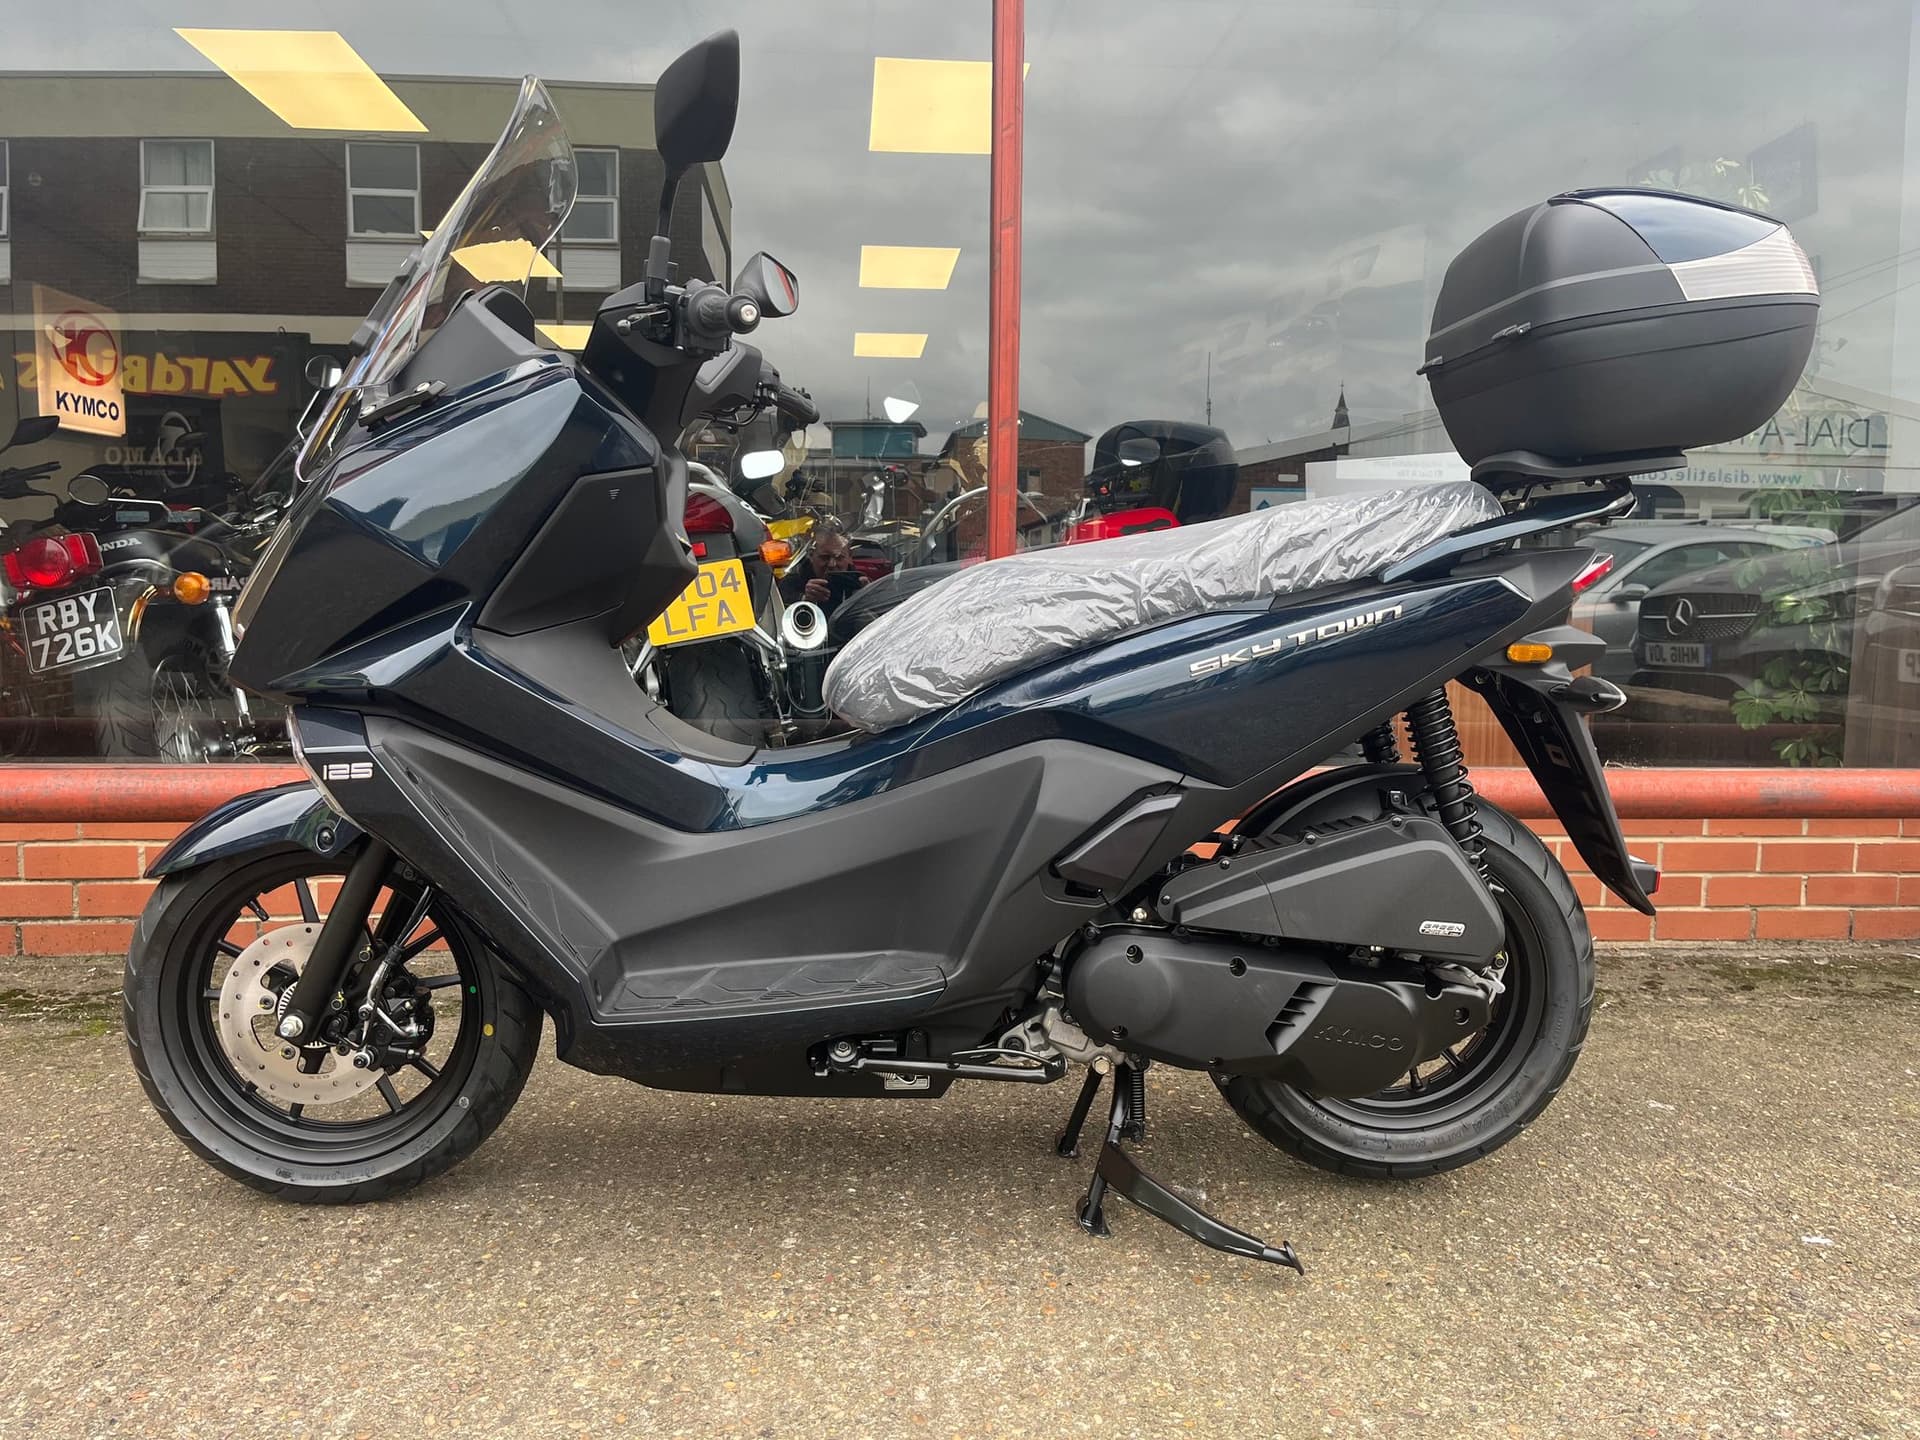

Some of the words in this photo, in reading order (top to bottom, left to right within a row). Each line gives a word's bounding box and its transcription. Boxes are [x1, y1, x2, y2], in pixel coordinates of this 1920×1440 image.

[56, 390, 120, 421] KYMCO
[98, 537, 143, 553] NDA
[680, 567, 741, 602] 04
[36, 592, 99, 636] RBY
[663, 600, 737, 637] LFA
[31, 619, 118, 668] 726K
[1189, 604, 1403, 678] SKYTOWN
[322, 762, 374, 780] 125
